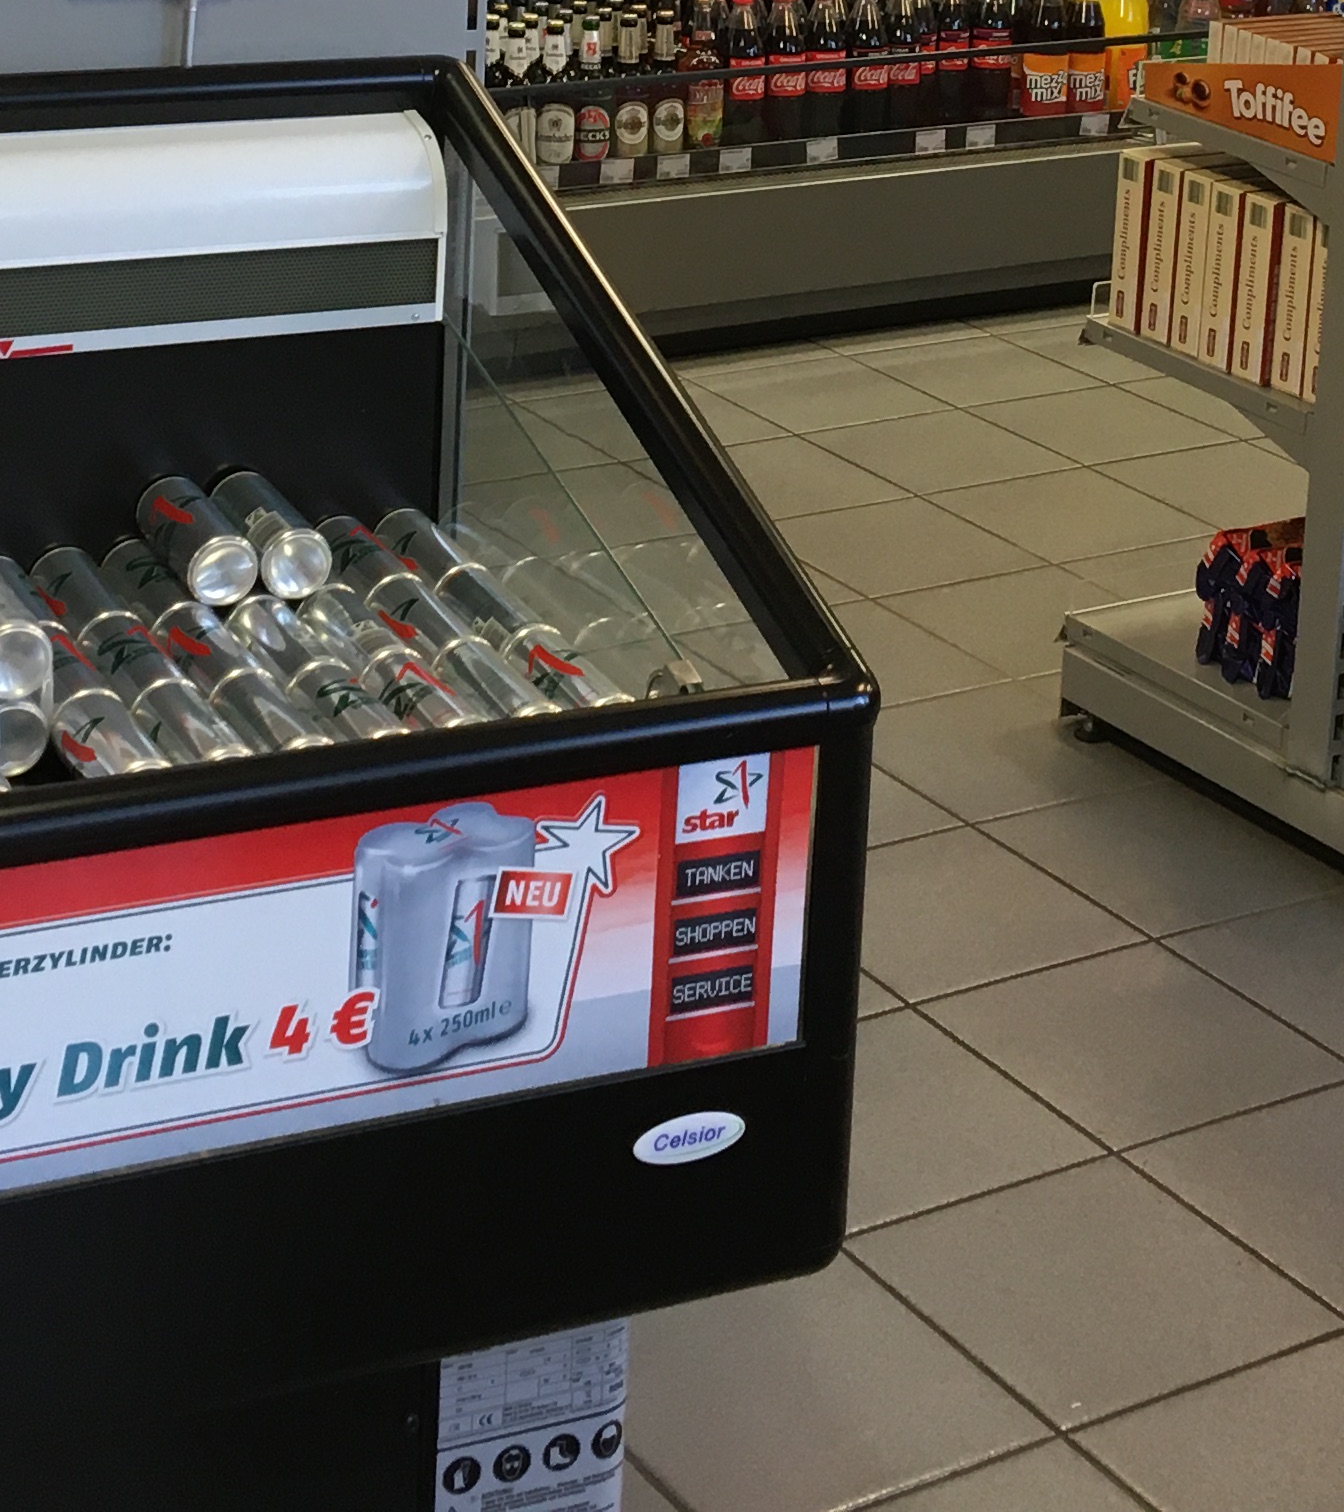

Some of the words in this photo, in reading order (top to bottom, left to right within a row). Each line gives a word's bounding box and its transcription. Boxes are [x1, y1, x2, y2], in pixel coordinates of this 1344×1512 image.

[1224, 79, 1327, 147] Toffifee
[1117, 188, 1132, 281] Compliments
[1150, 199, 1166, 294] Compliments
[1181, 211, 1197, 306] Compliments
[1209, 223, 1225, 318] Compliments
[1242, 233, 1259, 332] Compliments
[1283, 245, 1299, 342] Compliments
[682, 808, 740, 835] star
[505, 876, 562, 909] NEU
[685, 859, 754, 886] TANKEN
[674, 917, 757, 947] SHOPPEN
[672, 973, 753, 1003] SERVICE
[57, 1013, 252, 1098] Drink
[269, 1002, 311, 1055] 4
[330, 991, 376, 1047] €
[407, 1027, 433, 1048] 4x
[440, 1004, 495, 1038] 250ml
[653, 1122, 726, 1152] Celsior
